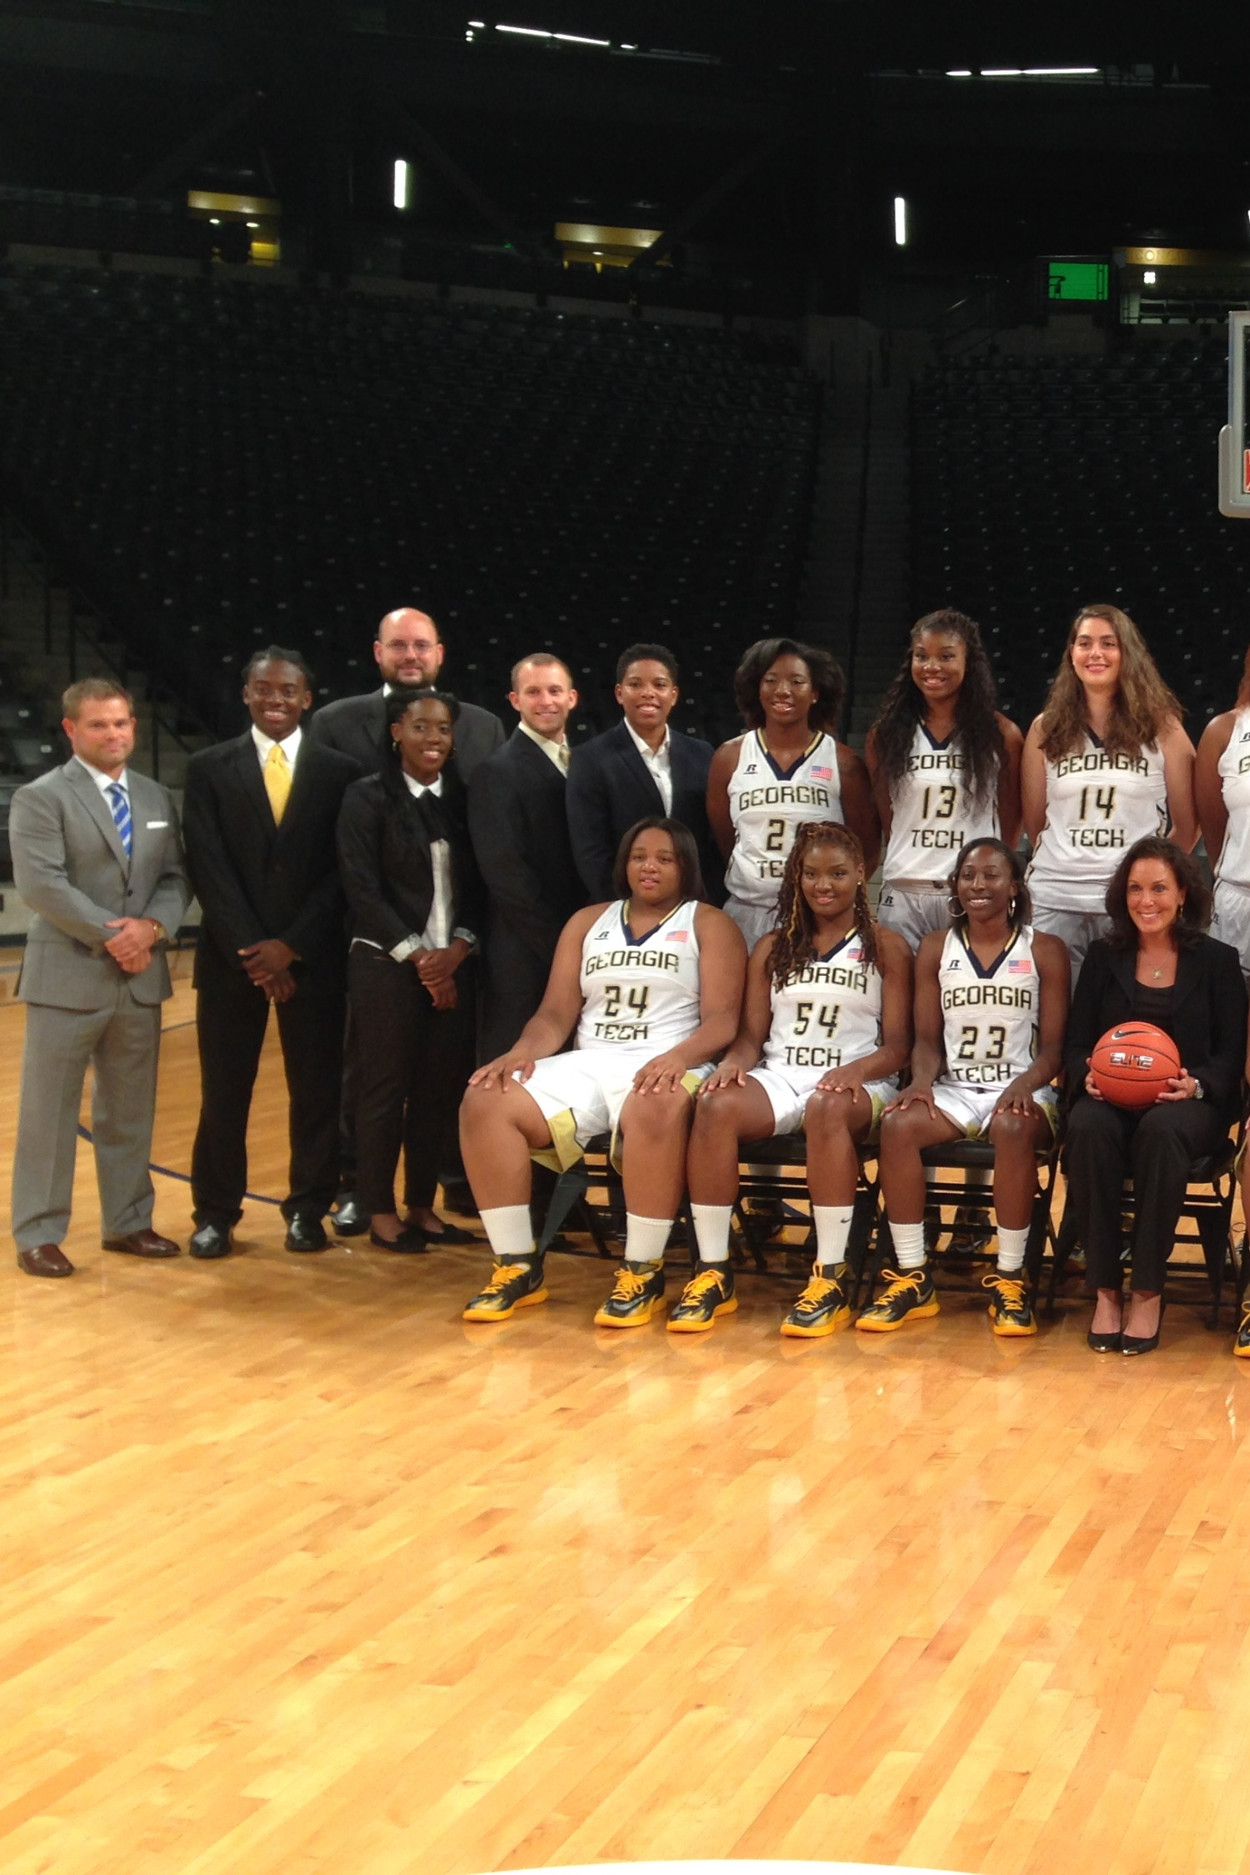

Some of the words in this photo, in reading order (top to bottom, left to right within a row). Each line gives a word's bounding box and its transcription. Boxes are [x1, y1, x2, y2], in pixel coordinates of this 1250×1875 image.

[905, 754, 966, 772] EORG
[1057, 753, 1149, 778] GEORGIA
[739, 785, 830, 811] GEORGIA
[922, 785, 957, 819] 13
[1079, 786, 1115, 820] 14
[766, 819, 803, 851] 2
[911, 830, 964, 848] TECH
[1069, 828, 1125, 847] TECH
[757, 860, 788, 878] TE
[585, 950, 679, 976] GEORGIA
[604, 985, 649, 1018] 24
[943, 985, 1032, 1010] GEORGIA
[594, 1023, 648, 1041] TECH
[793, 1003, 840, 1038] 54
[959, 1026, 1008, 1060] 23
[785, 1046, 841, 1067] TECH
[1109, 1052, 1154, 1070] ELITE
[952, 1064, 1011, 1083] TECH
